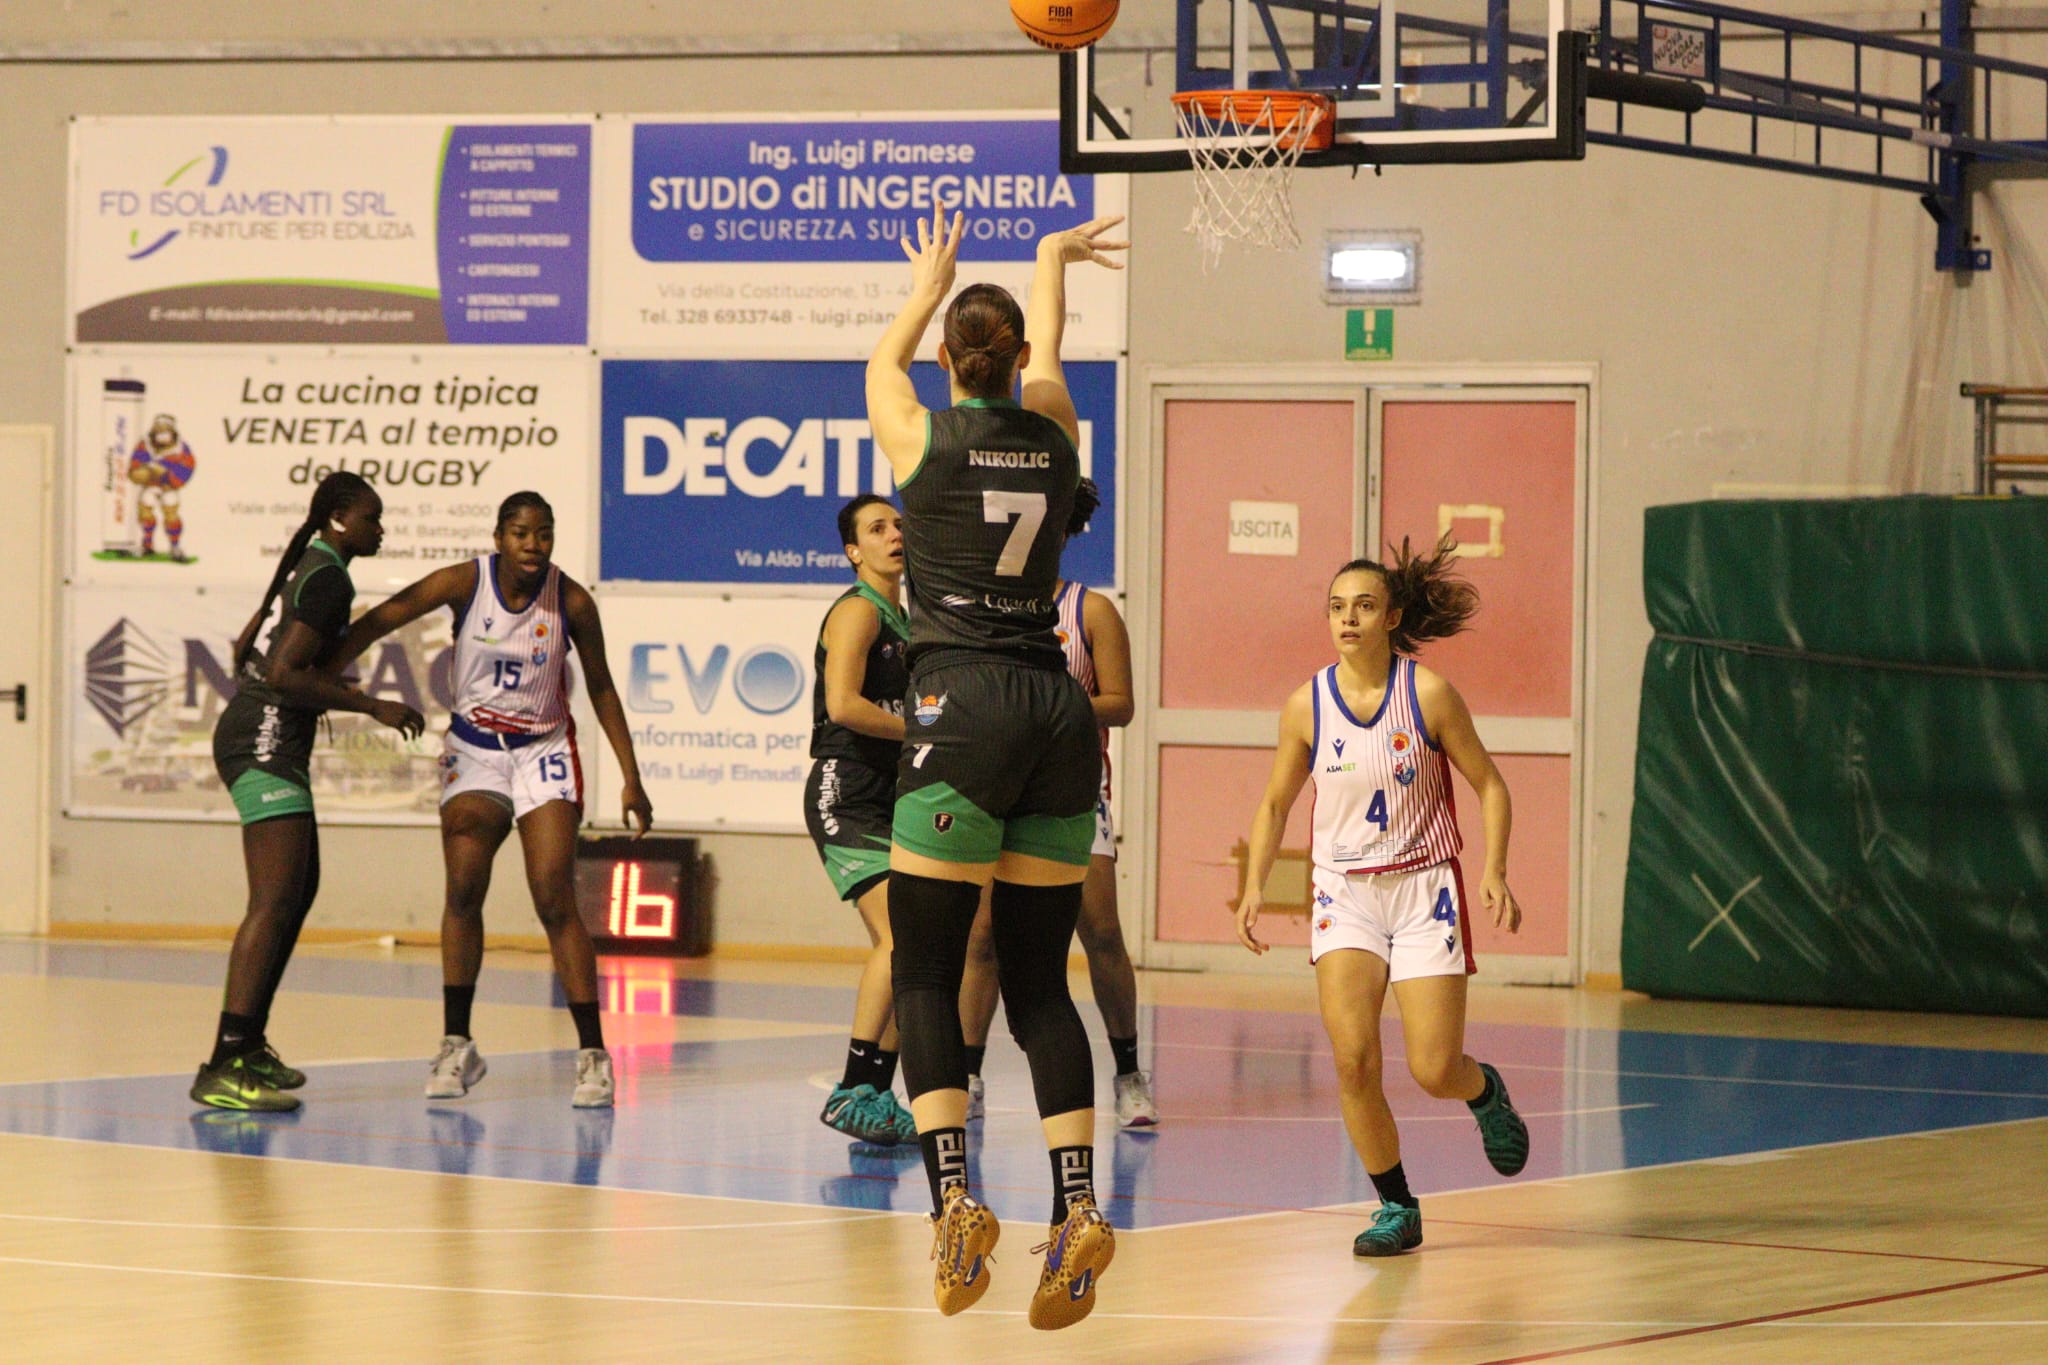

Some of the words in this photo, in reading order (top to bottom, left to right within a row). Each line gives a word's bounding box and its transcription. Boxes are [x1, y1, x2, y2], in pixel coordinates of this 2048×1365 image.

[1047, 6, 1073, 17] FIBA
[749, 141, 797, 170] Ing.
[807, 139, 865, 171] Luigi
[874, 141, 975, 164] Pianese
[99, 191, 140, 216] FD
[151, 191, 331, 216] ISOLAMENTI
[343, 191, 395, 216] SRL
[649, 176, 781, 211] STUDIO
[792, 175, 828, 211] di
[838, 173, 1077, 210] INGEGNERIA
[187, 222, 280, 241] FINITURE
[287, 222, 327, 241] PER
[333, 222, 416, 241] EDILIZIA
[688, 223, 704, 241] e
[714, 218, 857, 241] SICUREZZA
[867, 218, 911, 240] SUL
[657, 283, 686, 299] Via
[691, 282, 734, 299] della
[864, 283, 880, 299] 13
[640, 308, 667, 325] Tel.
[677, 308, 708, 325] 328
[714, 308, 792, 325] 6933748
[241, 377, 284, 405] La
[296, 376, 421, 405] cucina
[434, 377, 539, 412] tipica
[223, 418, 368, 445] VENETA
[381, 418, 416, 445] al
[428, 417, 559, 453] tempio
[357, 460, 492, 486] RUGBY
[968, 449, 1050, 469] NIKOLIC
[982, 490, 1048, 577] 7
[1230, 519, 1294, 539] USCITA
[736, 551, 762, 567] Via
[765, 550, 803, 567] Aldo
[493, 659, 523, 690] 15
[627, 643, 805, 716] EVO
[630, 722, 757, 749] nformatica
[766, 732, 806, 756] per
[539, 752, 567, 782] 15
[912, 743, 933, 770] 7
[640, 761, 672, 778] Via
[678, 761, 724, 785] Luigi
[1365, 789, 1389, 832] 4
[608, 861, 674, 937] 16
[1433, 886, 1457, 927] 4
